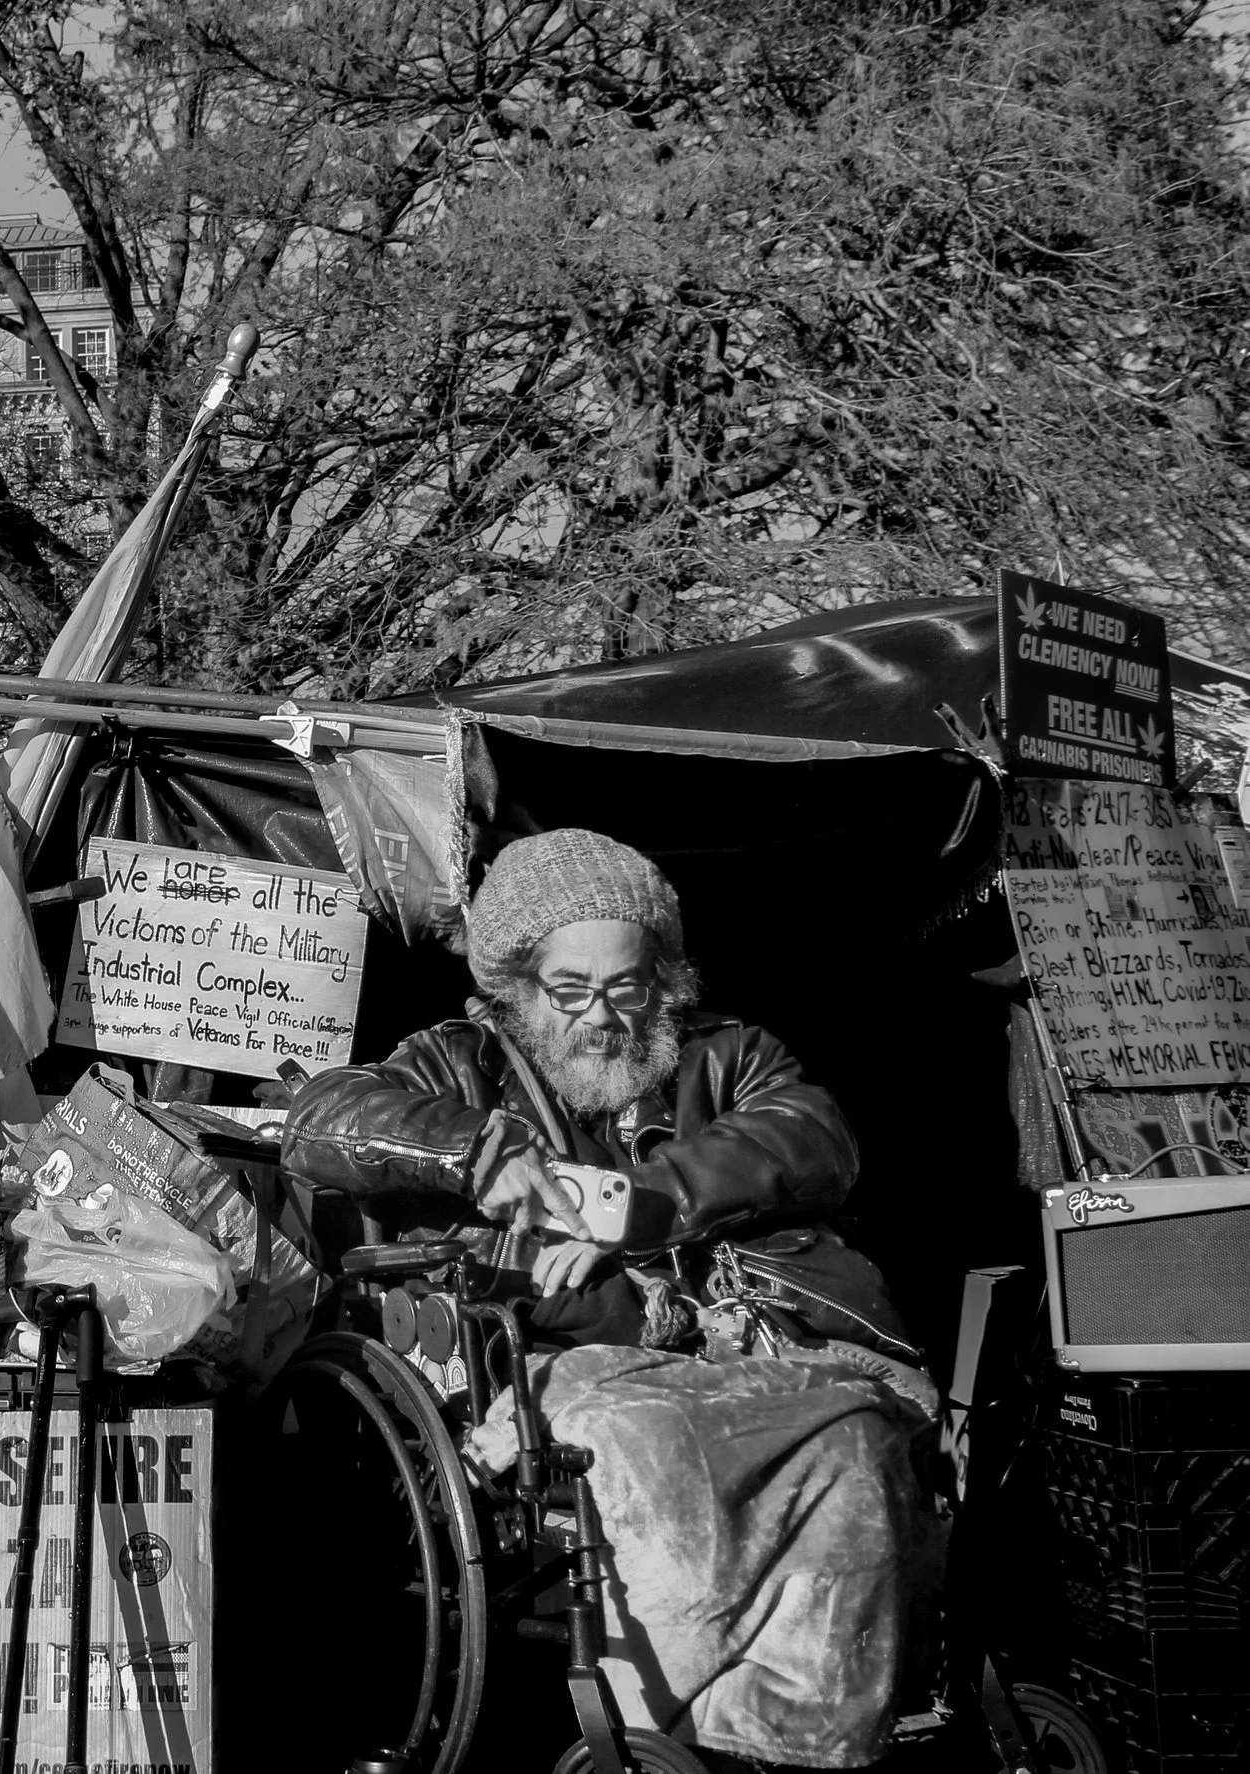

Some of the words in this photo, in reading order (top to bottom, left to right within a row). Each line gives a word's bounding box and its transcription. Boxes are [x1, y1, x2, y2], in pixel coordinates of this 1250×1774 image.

[1052, 602, 1079, 631] WE
[1083, 611, 1126, 644] NEED
[1019, 633, 1112, 679] CLEMENCY
[1116, 659, 1159, 691] NOW!
[1049, 695, 1097, 737] FREE
[1102, 708, 1137, 746] ALL
[1019, 735, 1089, 770] CANNABIS
[1092, 751, 1162, 786] PRISONERS
[103, 850, 148, 894] We
[253, 875, 282, 911] all
[294, 878, 337, 917] the
[191, 918, 222, 947] of
[231, 922, 268, 955] the
[278, 925, 349, 983] Military
[1018, 911, 1058, 947] Rain
[1065, 923, 1080, 938] or
[78, 940, 181, 986] Industrial
[72, 983, 96, 1004] The
[101, 986, 139, 1008] White
[143, 993, 181, 1012] House
[189, 997, 227, 1017] Peace
[235, 1004, 260, 1029] Vigil
[268, 1011, 316, 1031] Official
[187, 1017, 240, 1046] Veterans
[246, 1031, 266, 1050] For
[274, 1035, 312, 1058] Peace
[1110, 1043, 1206, 1077] MEMORIAL
[115, 1158, 140, 1187] THESE
[143, 1165, 192, 1210] RECYCLE
